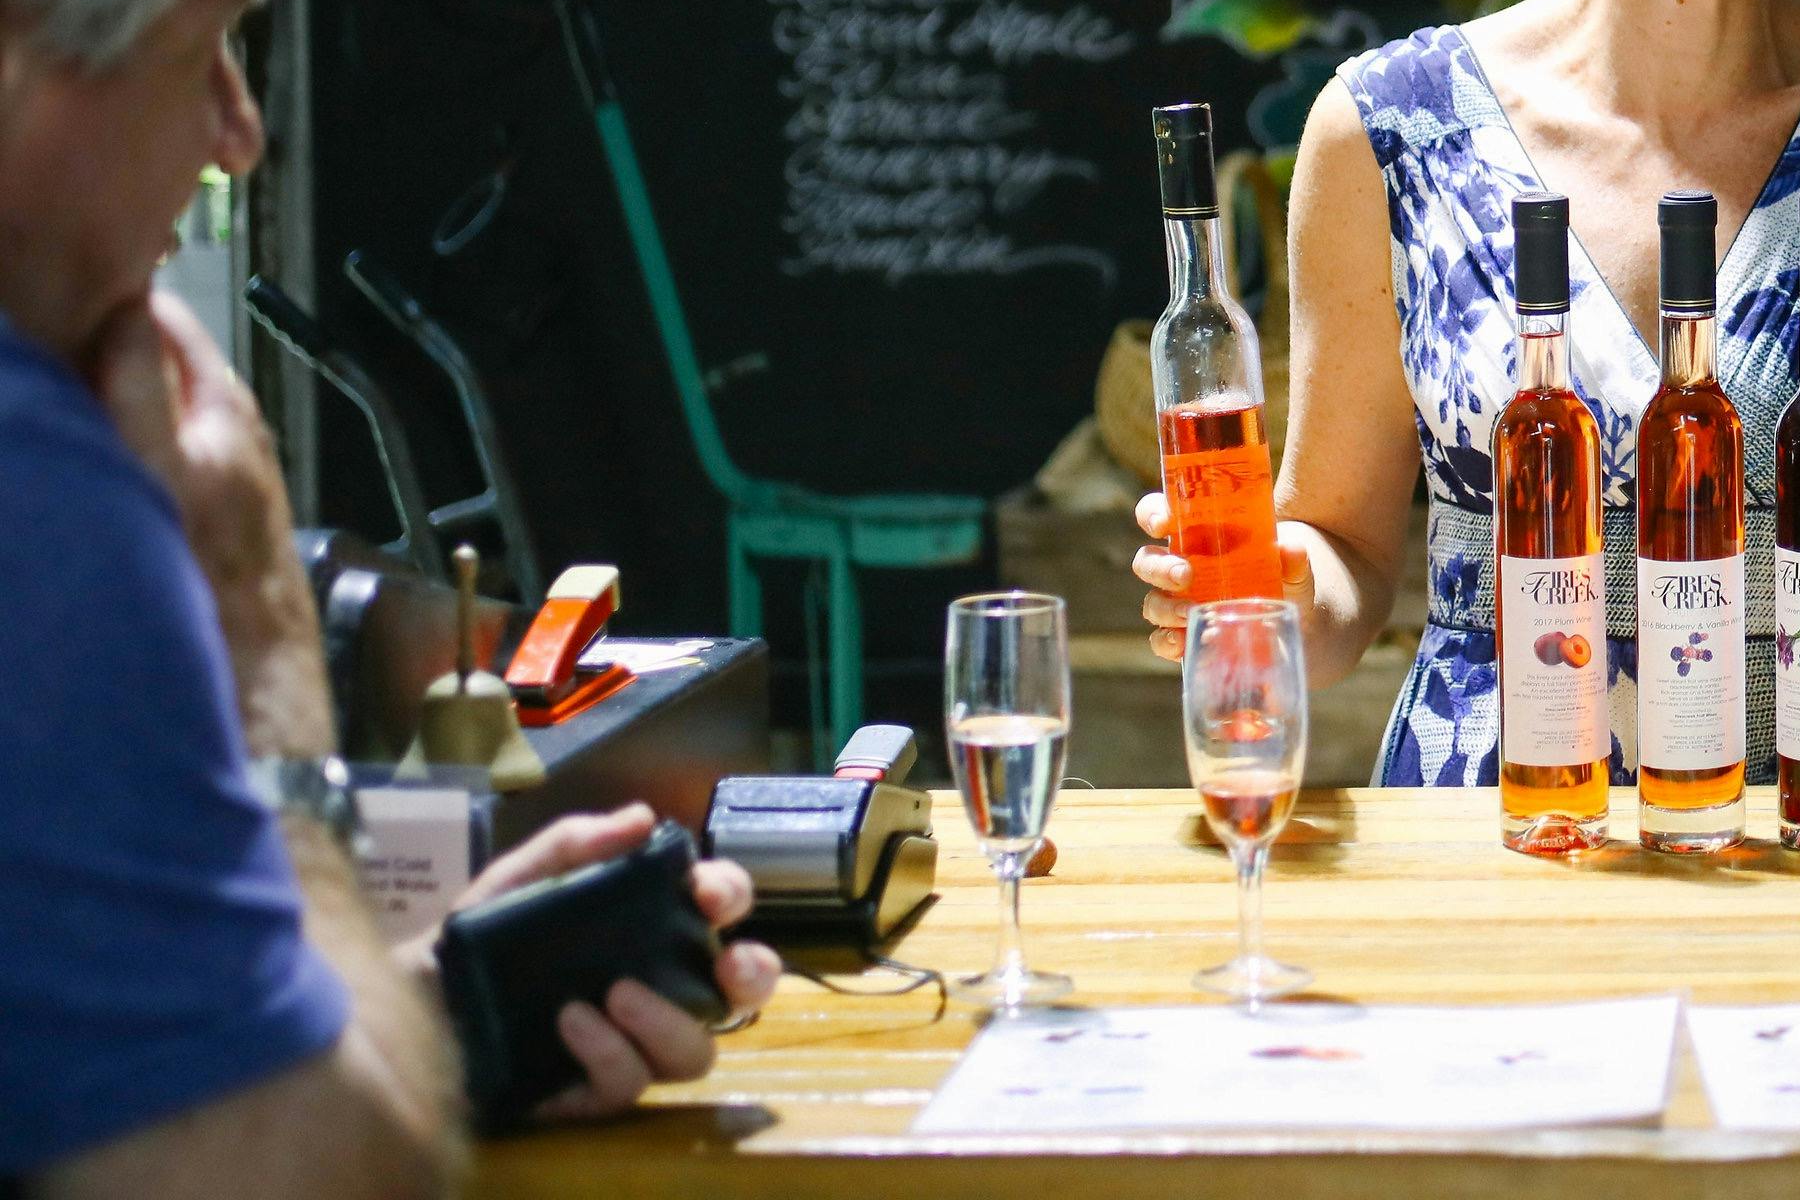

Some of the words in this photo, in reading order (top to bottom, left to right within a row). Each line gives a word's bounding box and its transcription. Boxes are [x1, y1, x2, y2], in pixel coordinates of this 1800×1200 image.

[1533, 584, 1599, 606] CREEK
[1662, 590, 1732, 609] CREEK
[1533, 618, 1553, 627] 2017
[1554, 617, 1575, 626] Plum
[1655, 621, 1696, 631] Blackberry
[1697, 622, 1704, 630] &
